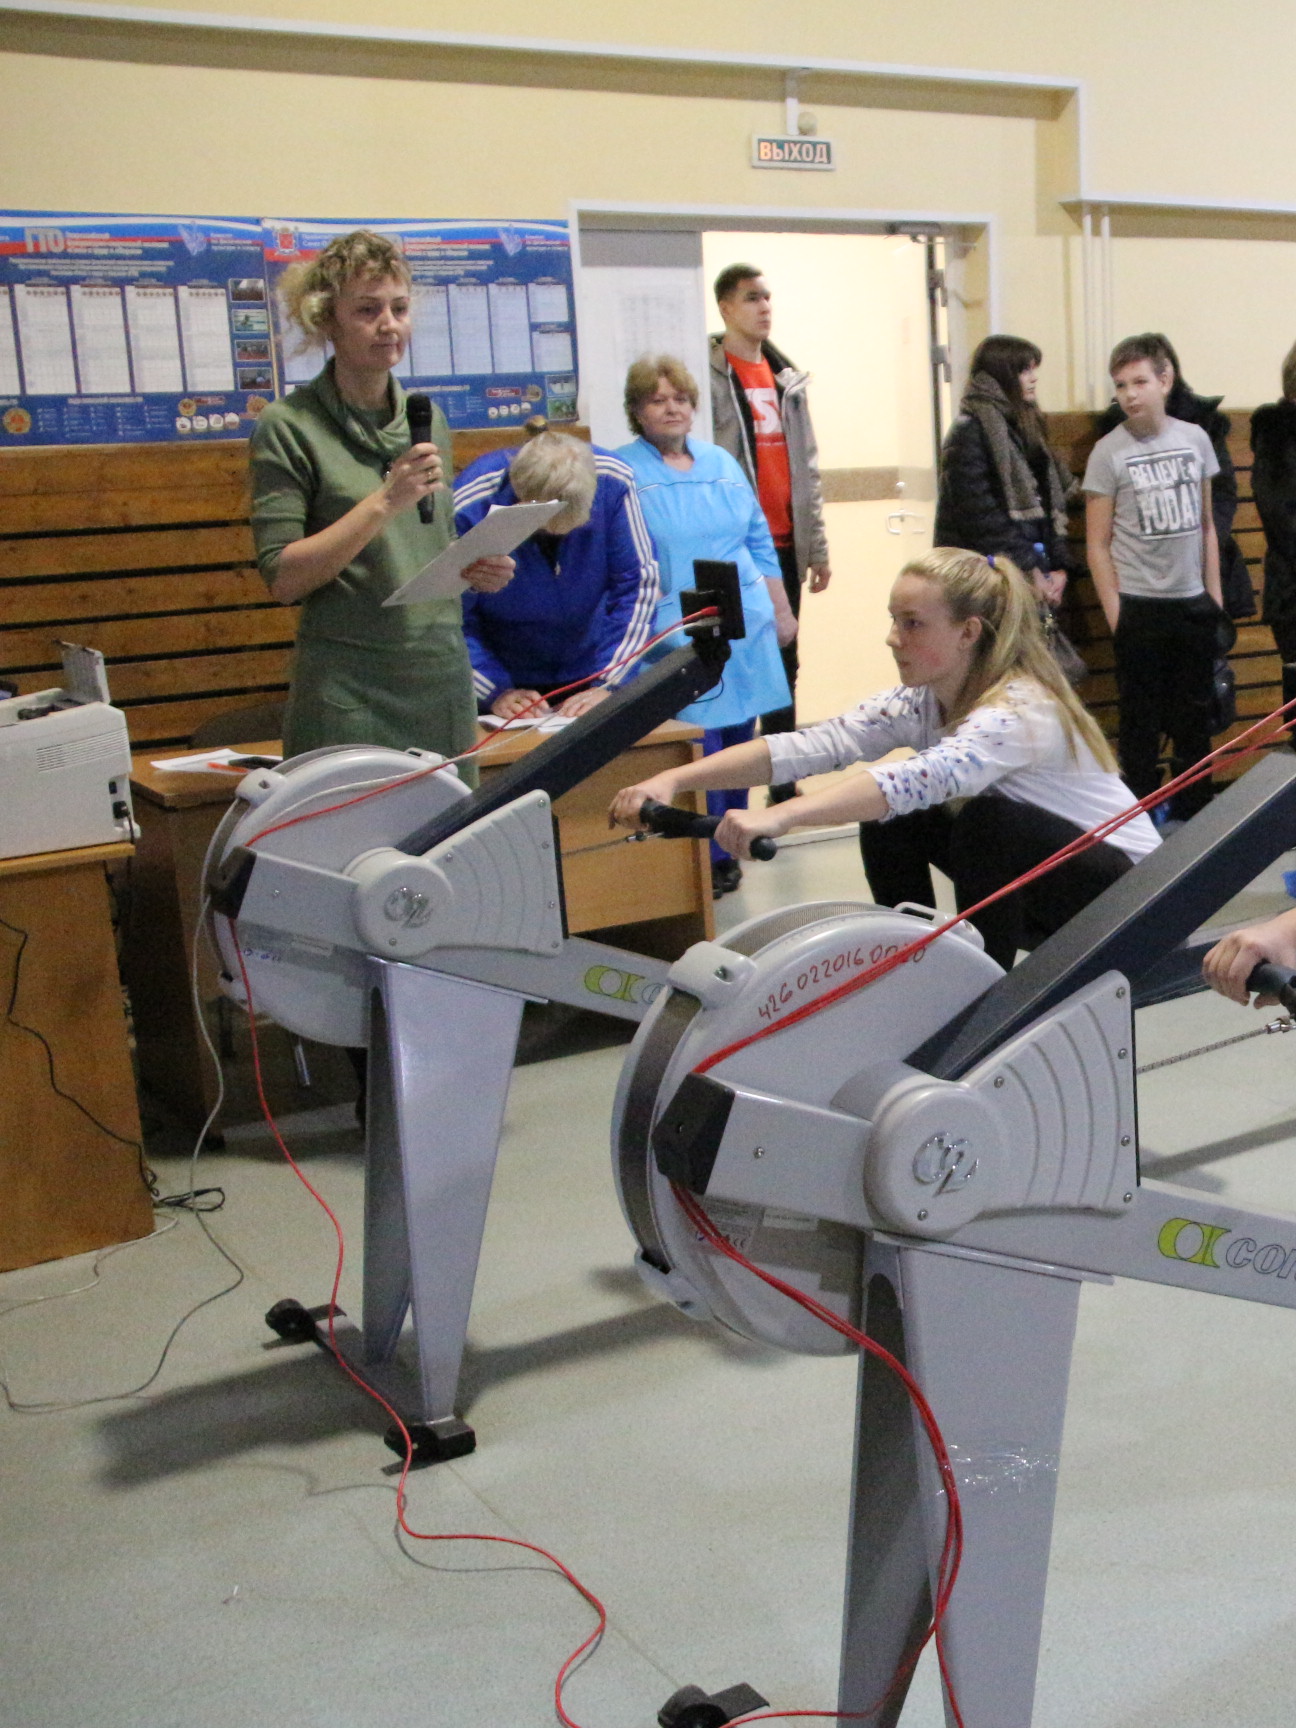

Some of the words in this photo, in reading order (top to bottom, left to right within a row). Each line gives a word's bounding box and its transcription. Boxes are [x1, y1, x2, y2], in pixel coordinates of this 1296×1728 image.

[759, 141, 828, 164] ВЫХОД
[24, 227, 65, 253] ГТО
[1128, 457, 1189, 490] BELIEVE
[758, 982, 793, 1020] 426
